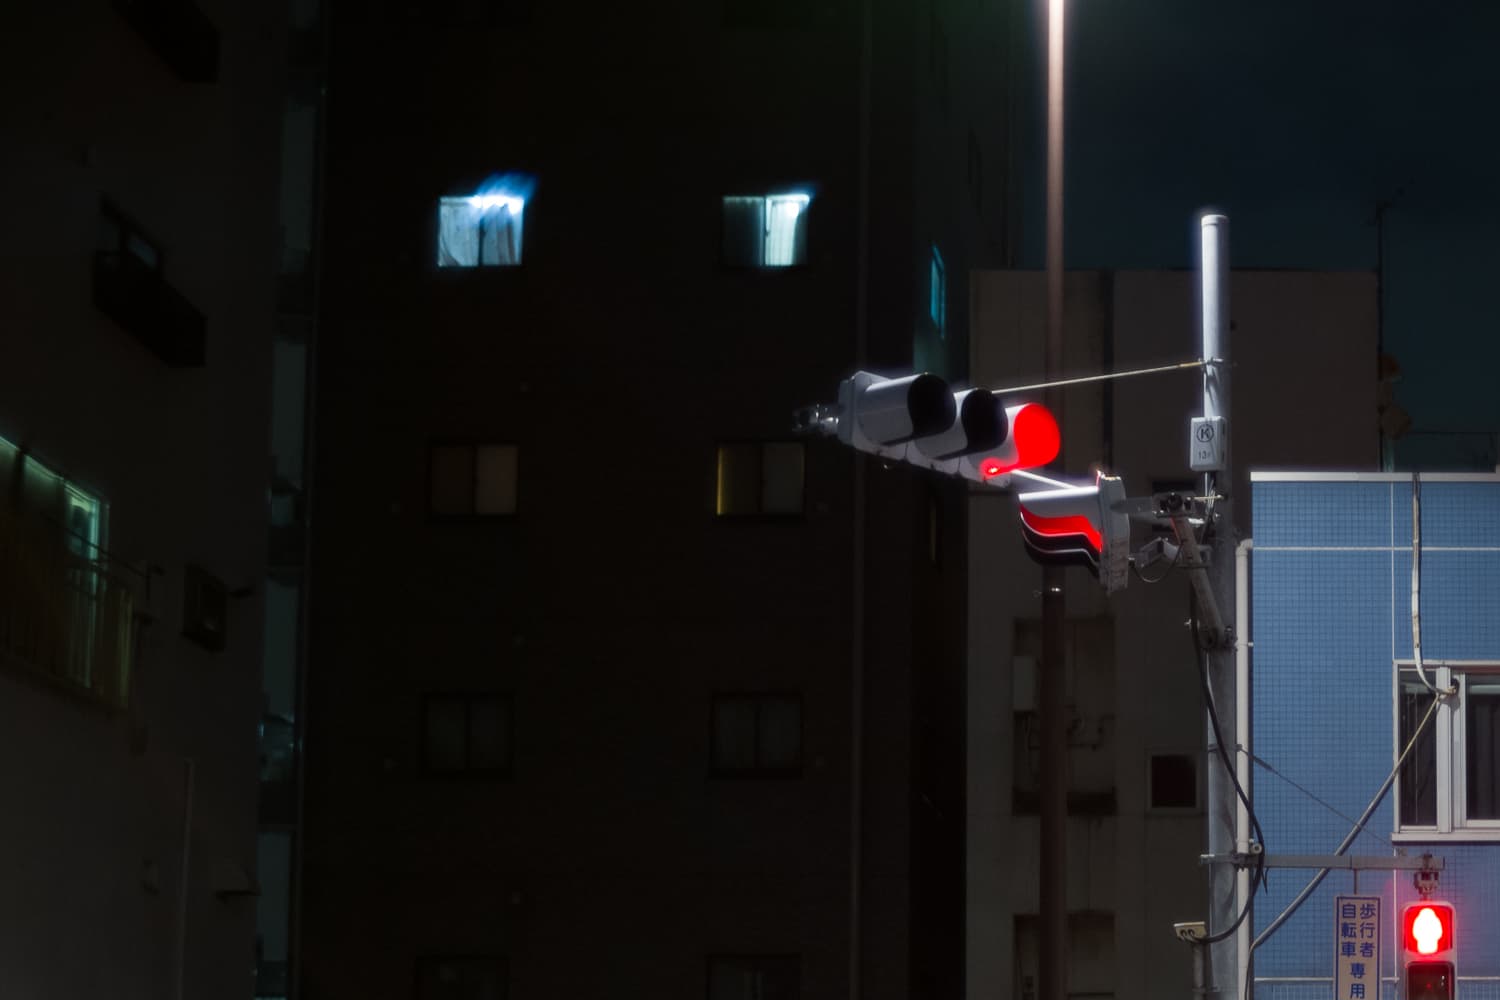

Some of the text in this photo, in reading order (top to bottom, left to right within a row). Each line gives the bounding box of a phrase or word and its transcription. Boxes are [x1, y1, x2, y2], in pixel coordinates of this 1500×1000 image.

[1340, 903, 1357, 958] 自転車
[1359, 903, 1376, 958] 歩行者
[1350, 962, 1365, 1000] 専用
